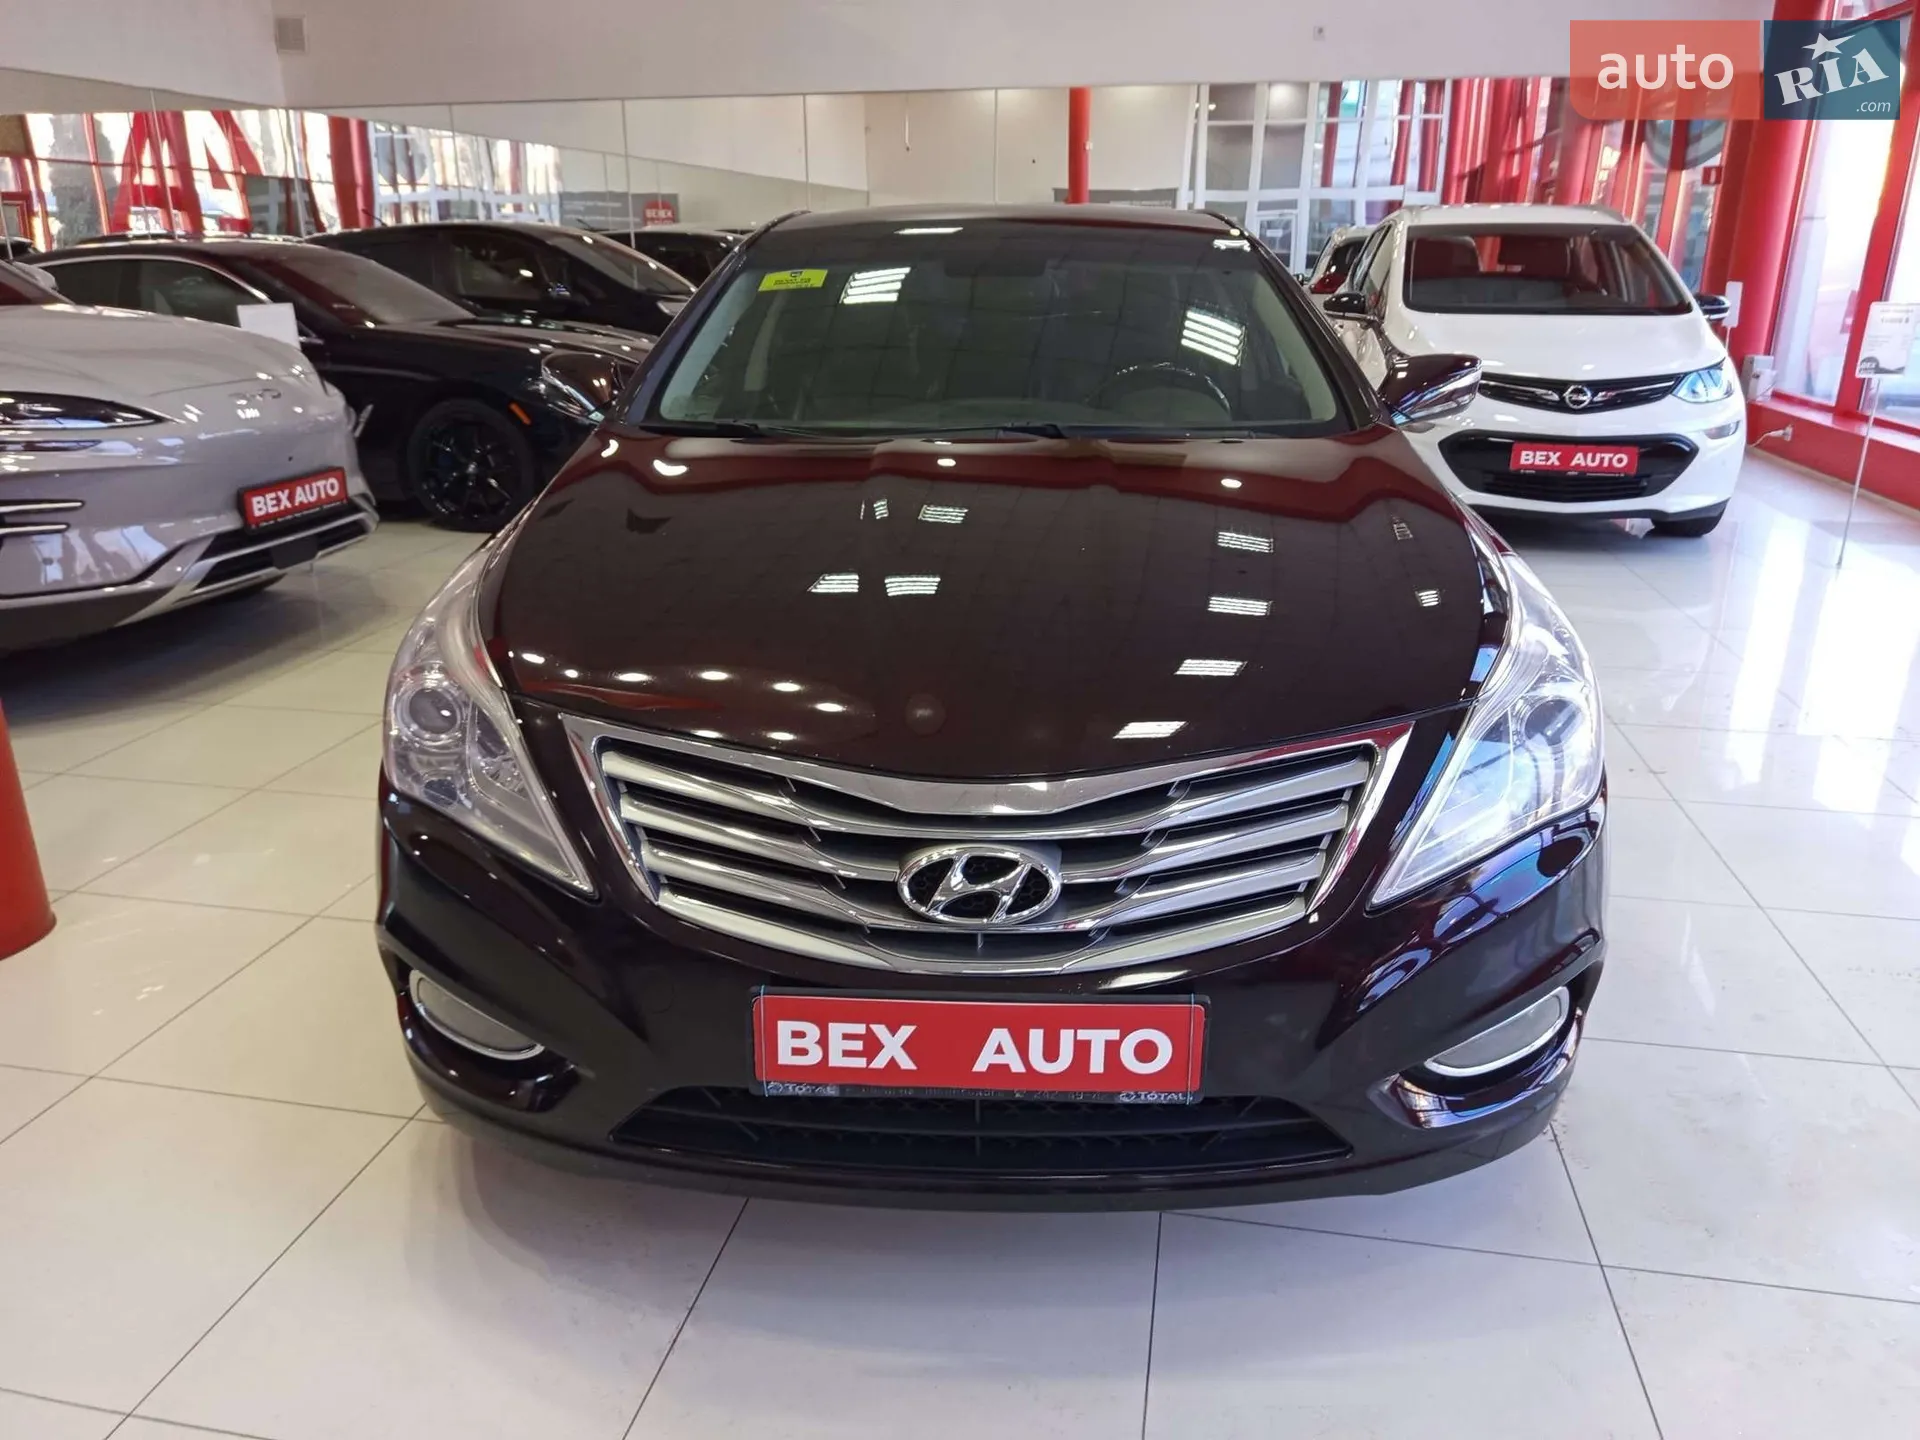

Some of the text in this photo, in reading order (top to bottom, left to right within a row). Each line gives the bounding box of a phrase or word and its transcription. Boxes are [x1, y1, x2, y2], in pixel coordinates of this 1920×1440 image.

[1520, 450, 1629, 468] BEX AUTO
[252, 489, 292, 517] BEX
[294, 478, 339, 506] AUTO
[777, 1020, 1173, 1075] BEX AUTO
